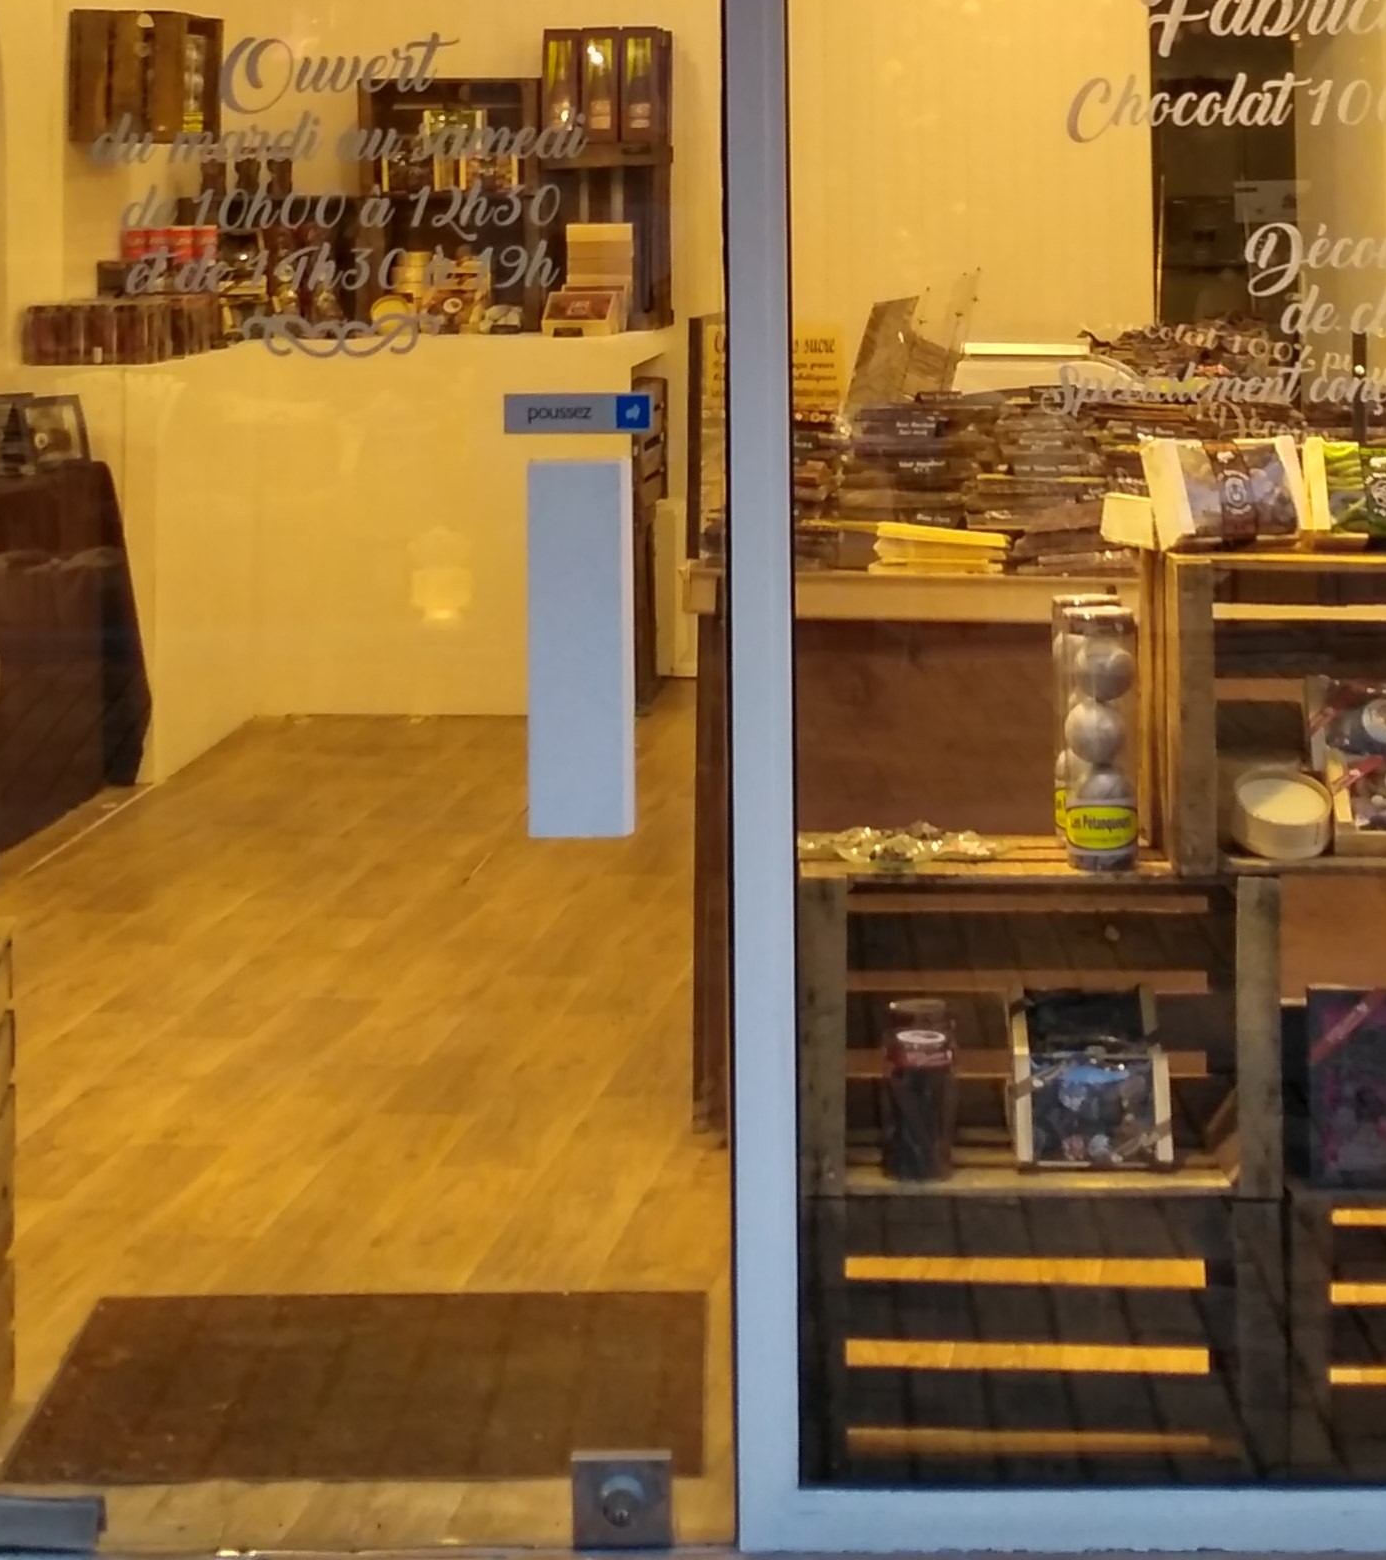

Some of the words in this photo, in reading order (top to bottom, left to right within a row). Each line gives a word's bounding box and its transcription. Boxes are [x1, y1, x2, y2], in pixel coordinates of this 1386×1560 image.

[221, 32, 460, 114] Ouvert
[1067, 72, 1312, 143] Chocolat
[91, 113, 155, 165] du
[170, 110, 320, 165] mardi
[335, 125, 400, 161] au
[412, 113, 588, 162] samedi
[122, 183, 177, 229] de
[194, 183, 345, 230] 10h00
[359, 183, 396, 228] à
[408, 183, 561, 241] 12h30
[126, 249, 172, 293] et
[175, 248, 235, 292] de
[1282, 285, 1331, 336] de
[527, 405, 591, 424] poussez
